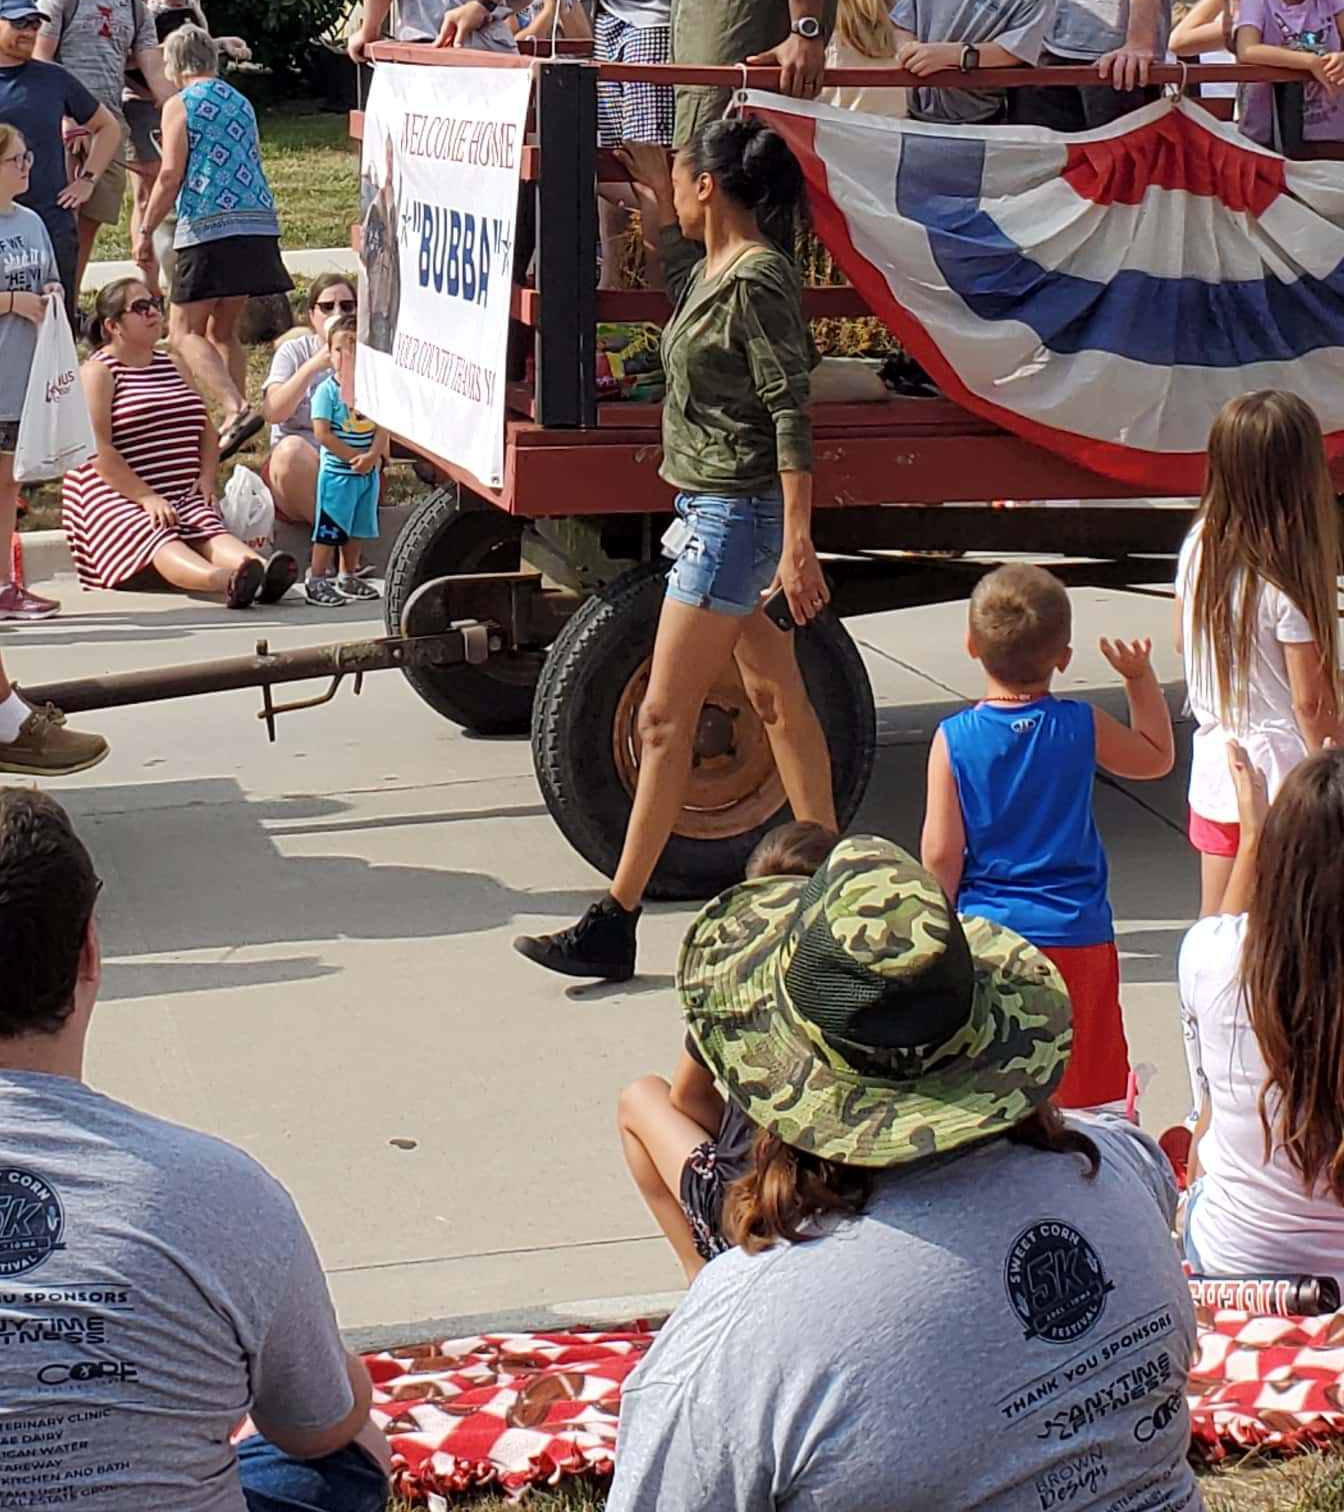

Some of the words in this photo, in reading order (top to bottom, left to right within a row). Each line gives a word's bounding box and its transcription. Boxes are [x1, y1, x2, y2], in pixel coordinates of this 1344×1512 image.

[467, 120, 517, 169] HOME
[413, 199, 503, 309] "BUBBA"
[9, 1172, 51, 1200] CORN
[1009, 1231, 1037, 1284] SWEET
[1040, 1224, 1080, 1245] CORN
[23, 1291, 128, 1304] SPONSORS
[1052, 1304, 1098, 1337] FESTIVAL
[1001, 1378, 1059, 1418] THANK
[1064, 1355, 1099, 1382] YOU
[1069, 1352, 1170, 1424] ANYTIME
[67, 1408, 113, 1424] CLINIC
[22, 1430, 64, 1445] DAIRY
[40, 1441, 89, 1456] WATER
[0, 1472, 60, 1486] KITCHEN
[64, 1467, 94, 1480] AND
[1035, 1443, 1104, 1494] BROWN
[1039, 1464, 1108, 1511] Design
